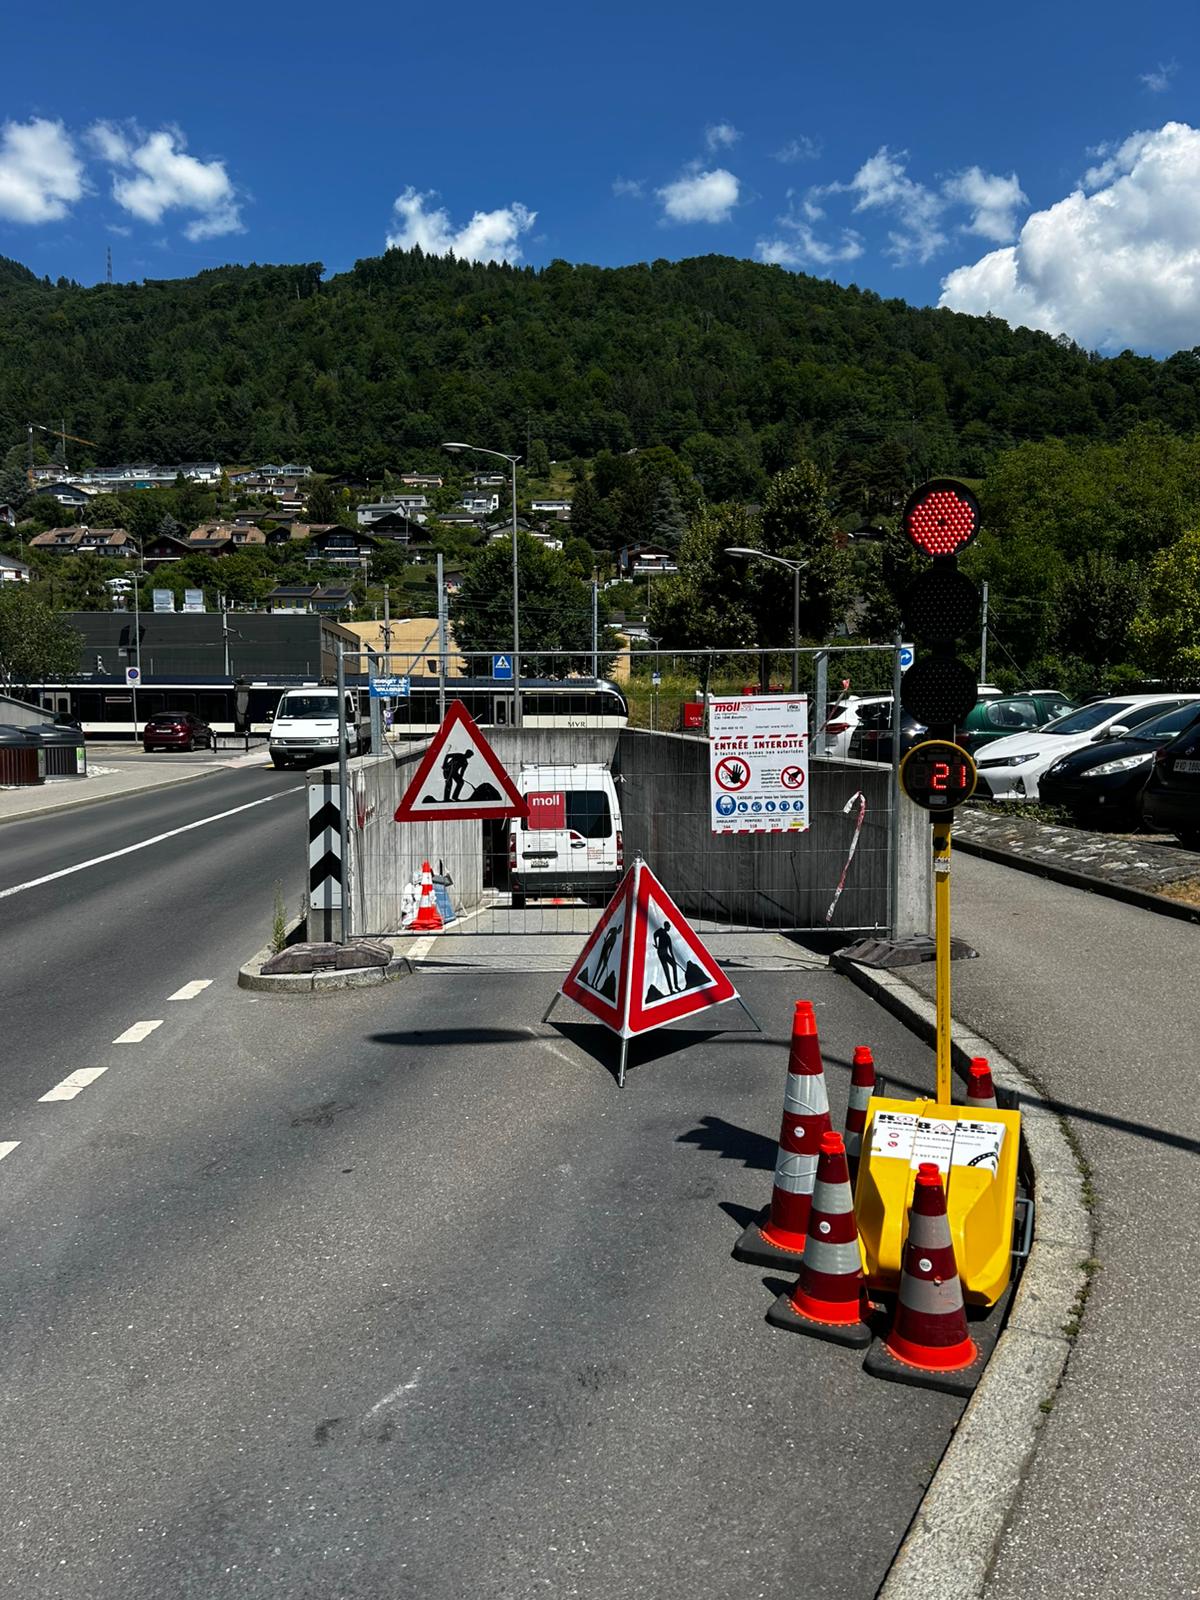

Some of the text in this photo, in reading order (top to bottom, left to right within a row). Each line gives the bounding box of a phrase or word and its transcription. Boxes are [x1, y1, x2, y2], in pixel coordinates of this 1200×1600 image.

[715, 702, 741, 712] moll
[714, 740, 804, 750] ENTRÉE INTERDITE
[930, 762, 968, 791] 21
[532, 795, 560, 806] moll
